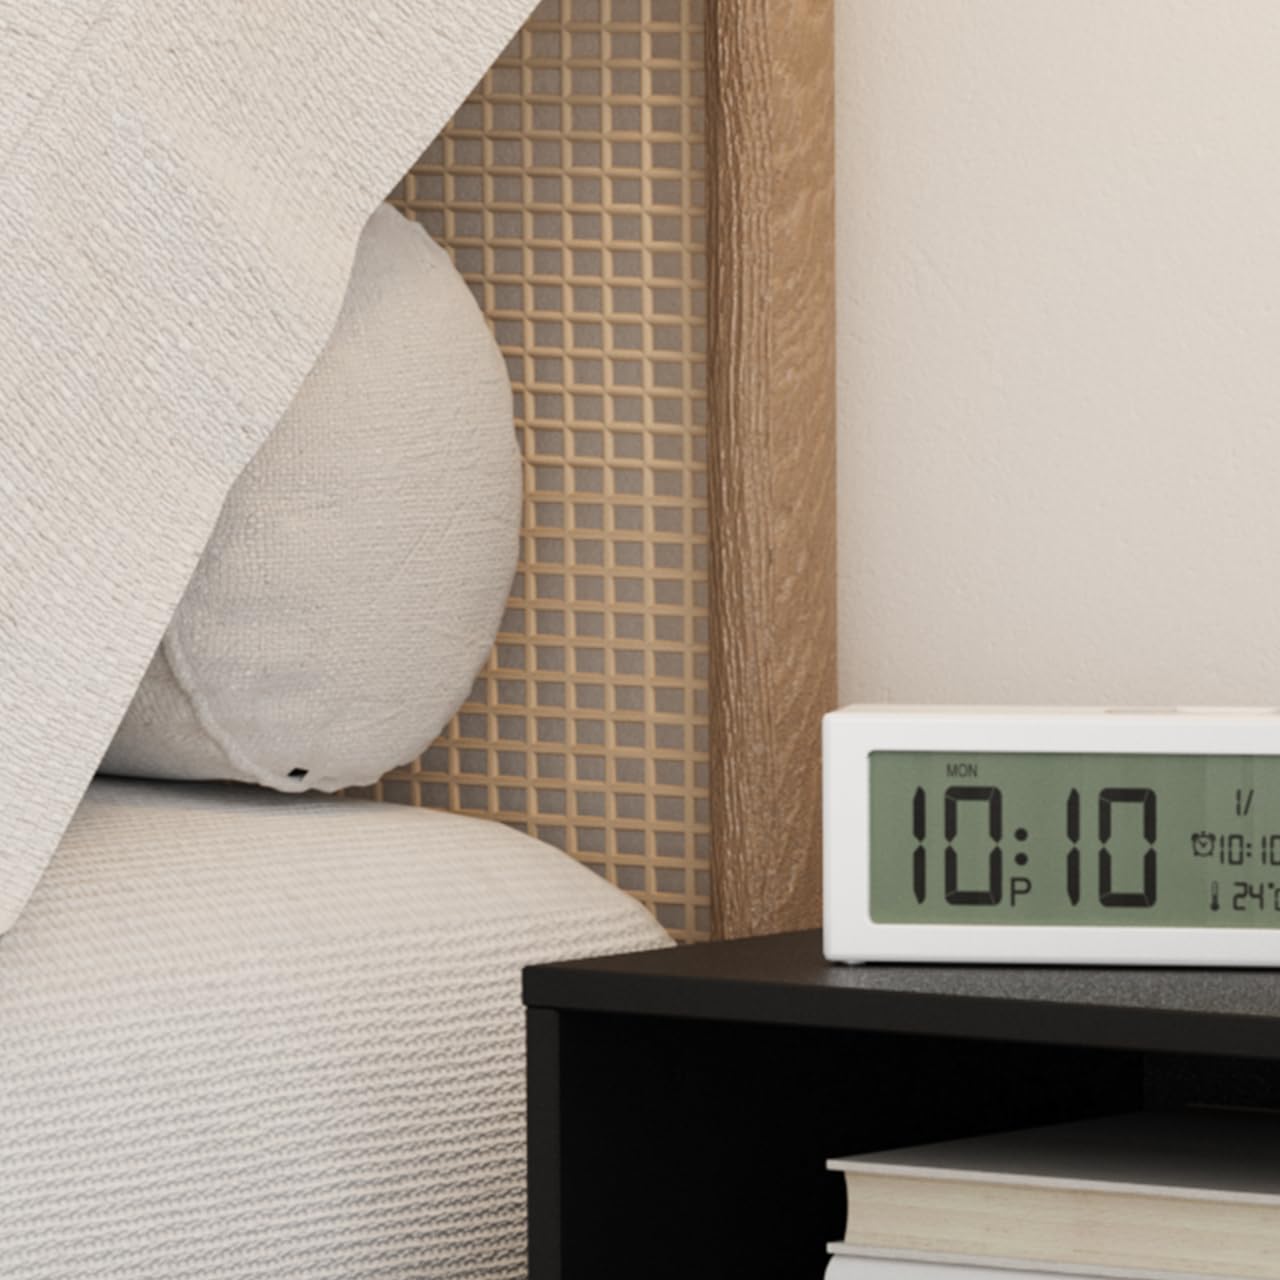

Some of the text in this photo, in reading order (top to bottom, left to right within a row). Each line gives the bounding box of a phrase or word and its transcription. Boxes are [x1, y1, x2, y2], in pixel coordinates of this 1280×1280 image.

[946, 763, 978, 777] MON
[912, 785, 1158, 908] 10:10
[1010, 876, 1033, 908] P
